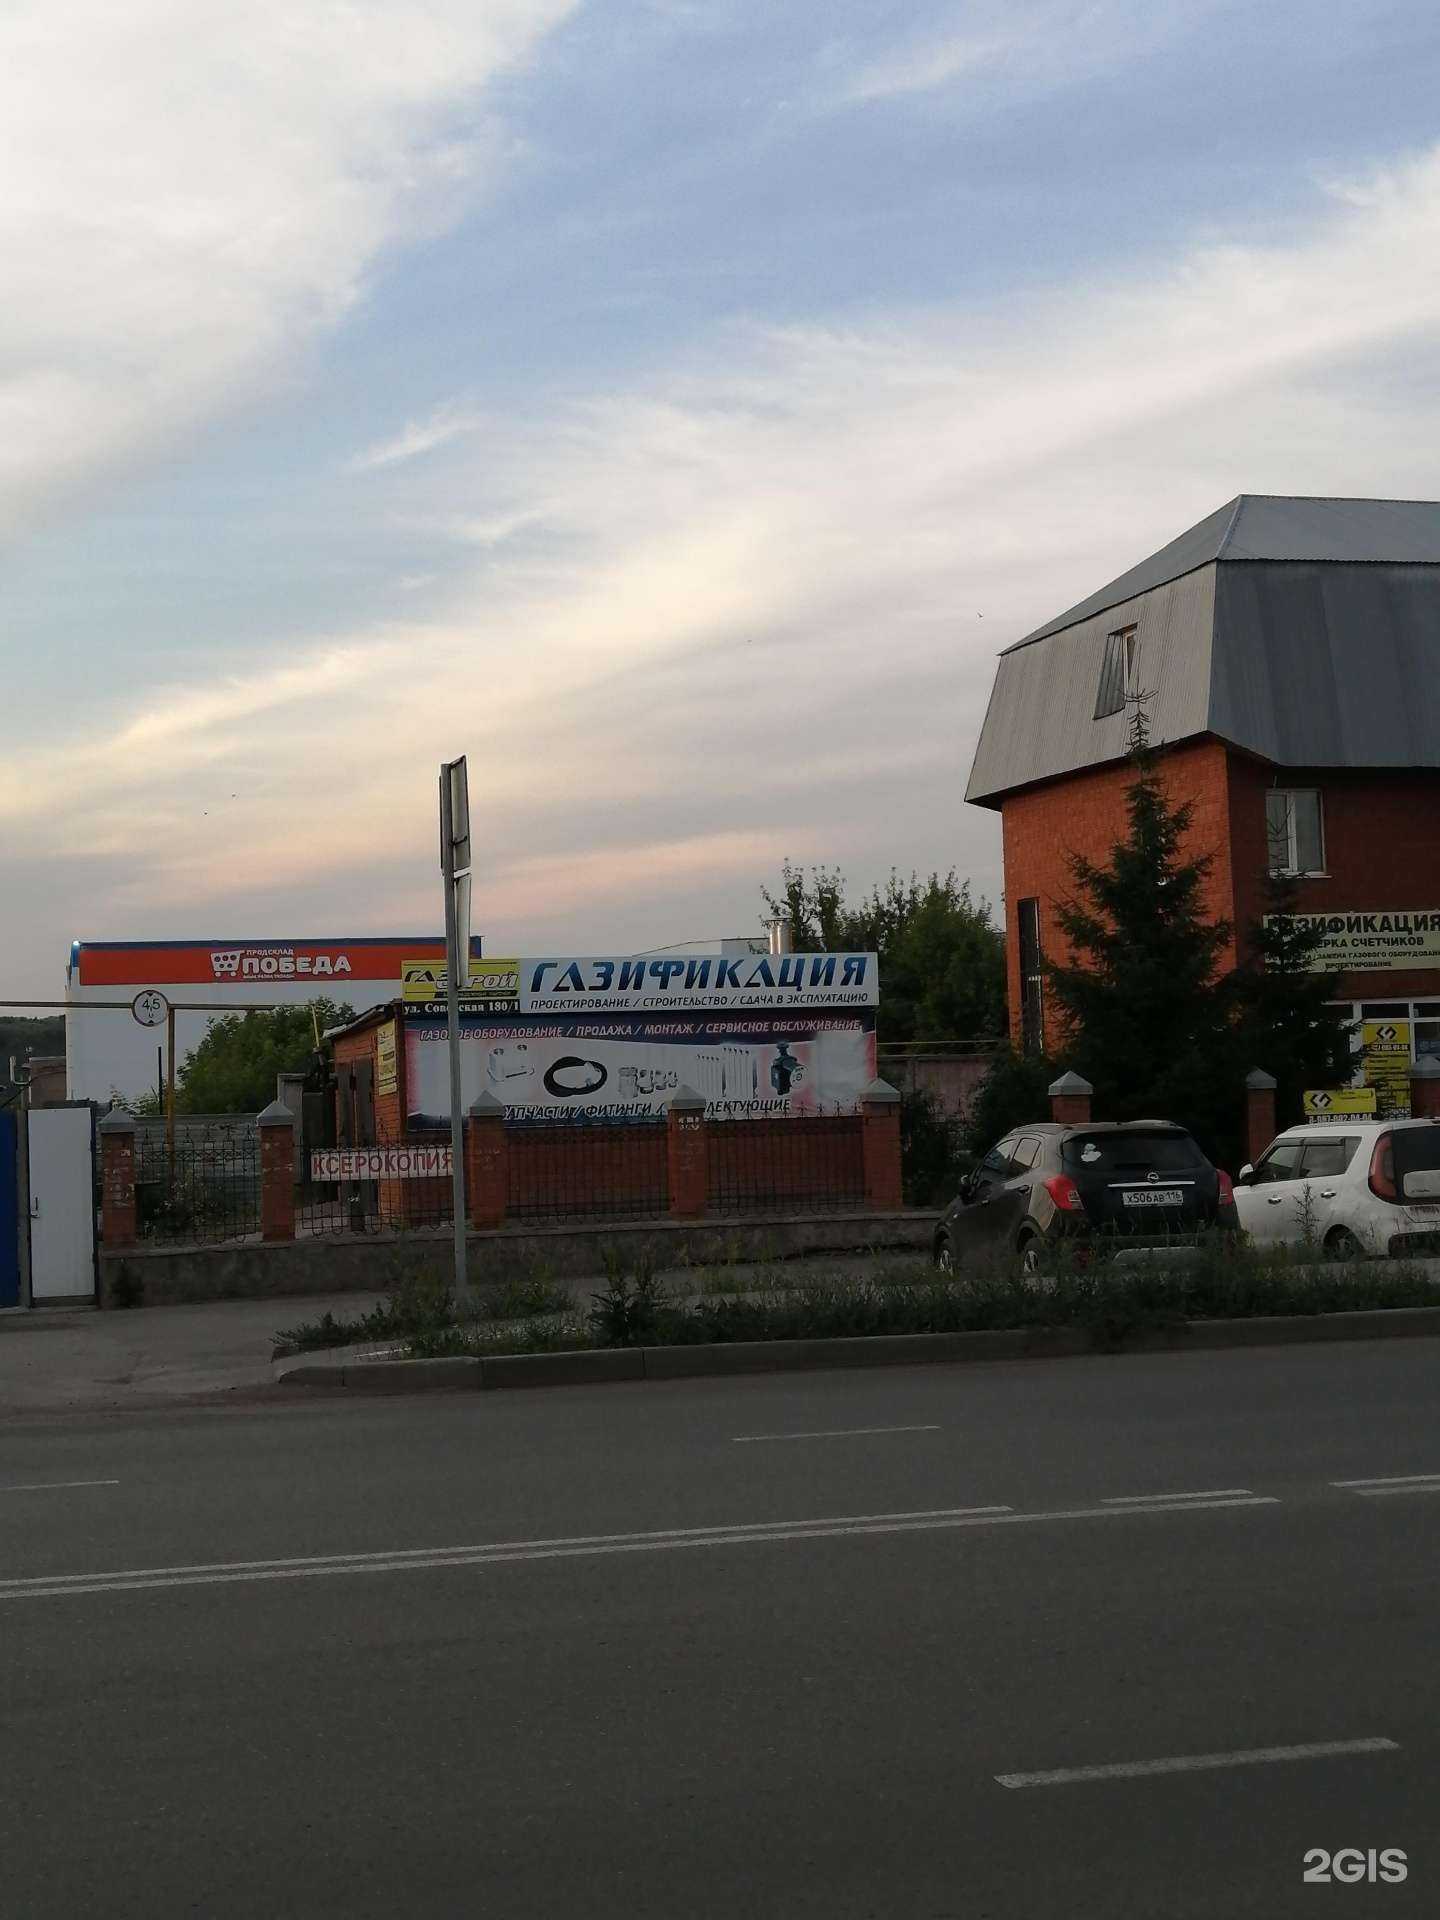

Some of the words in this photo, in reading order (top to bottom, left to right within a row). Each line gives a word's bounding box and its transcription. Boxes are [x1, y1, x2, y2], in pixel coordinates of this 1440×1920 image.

[1351, 936, 1424, 948] СЧЕТЧИКОВ
[1348, 951, 1387, 959] ГАЗОВОГО
[242, 955, 352, 975] ПОБЕДА
[1325, 961, 1391, 970] ПРОЕКТИРОВАНИЕ
[530, 957, 867, 993] ГАЗИФИКАЦИЯ
[404, 1006, 421, 1017] ул.
[489, 1001, 519, 1012] 180/1
[530, 999, 630, 1010] ПРОЕКТИРОВАНИЕ
[643, 996, 728, 1007] СТРОИТЕЛЬСТВО
[740, 995, 774, 1005] СДАЧА
[776, 995, 784, 1004] В
[787, 992, 868, 1005] ЭКСПЛУАТАЦИЮ
[474, 1027, 562, 1040] ОБОРУДОВАНИЕ
[576, 1024, 632, 1036] ПРОДАЖА
[644, 1023, 694, 1036] МОНТАЖ
[706, 1020, 769, 1033] СЕРВИСНОЕ
[773, 1018, 861, 1032] ОБСЛУЖИВАНИЕ
[585, 1103, 652, 1117] ФИТИНГИ
[312, 1151, 452, 1175] КСЕРОКОПИЯ
